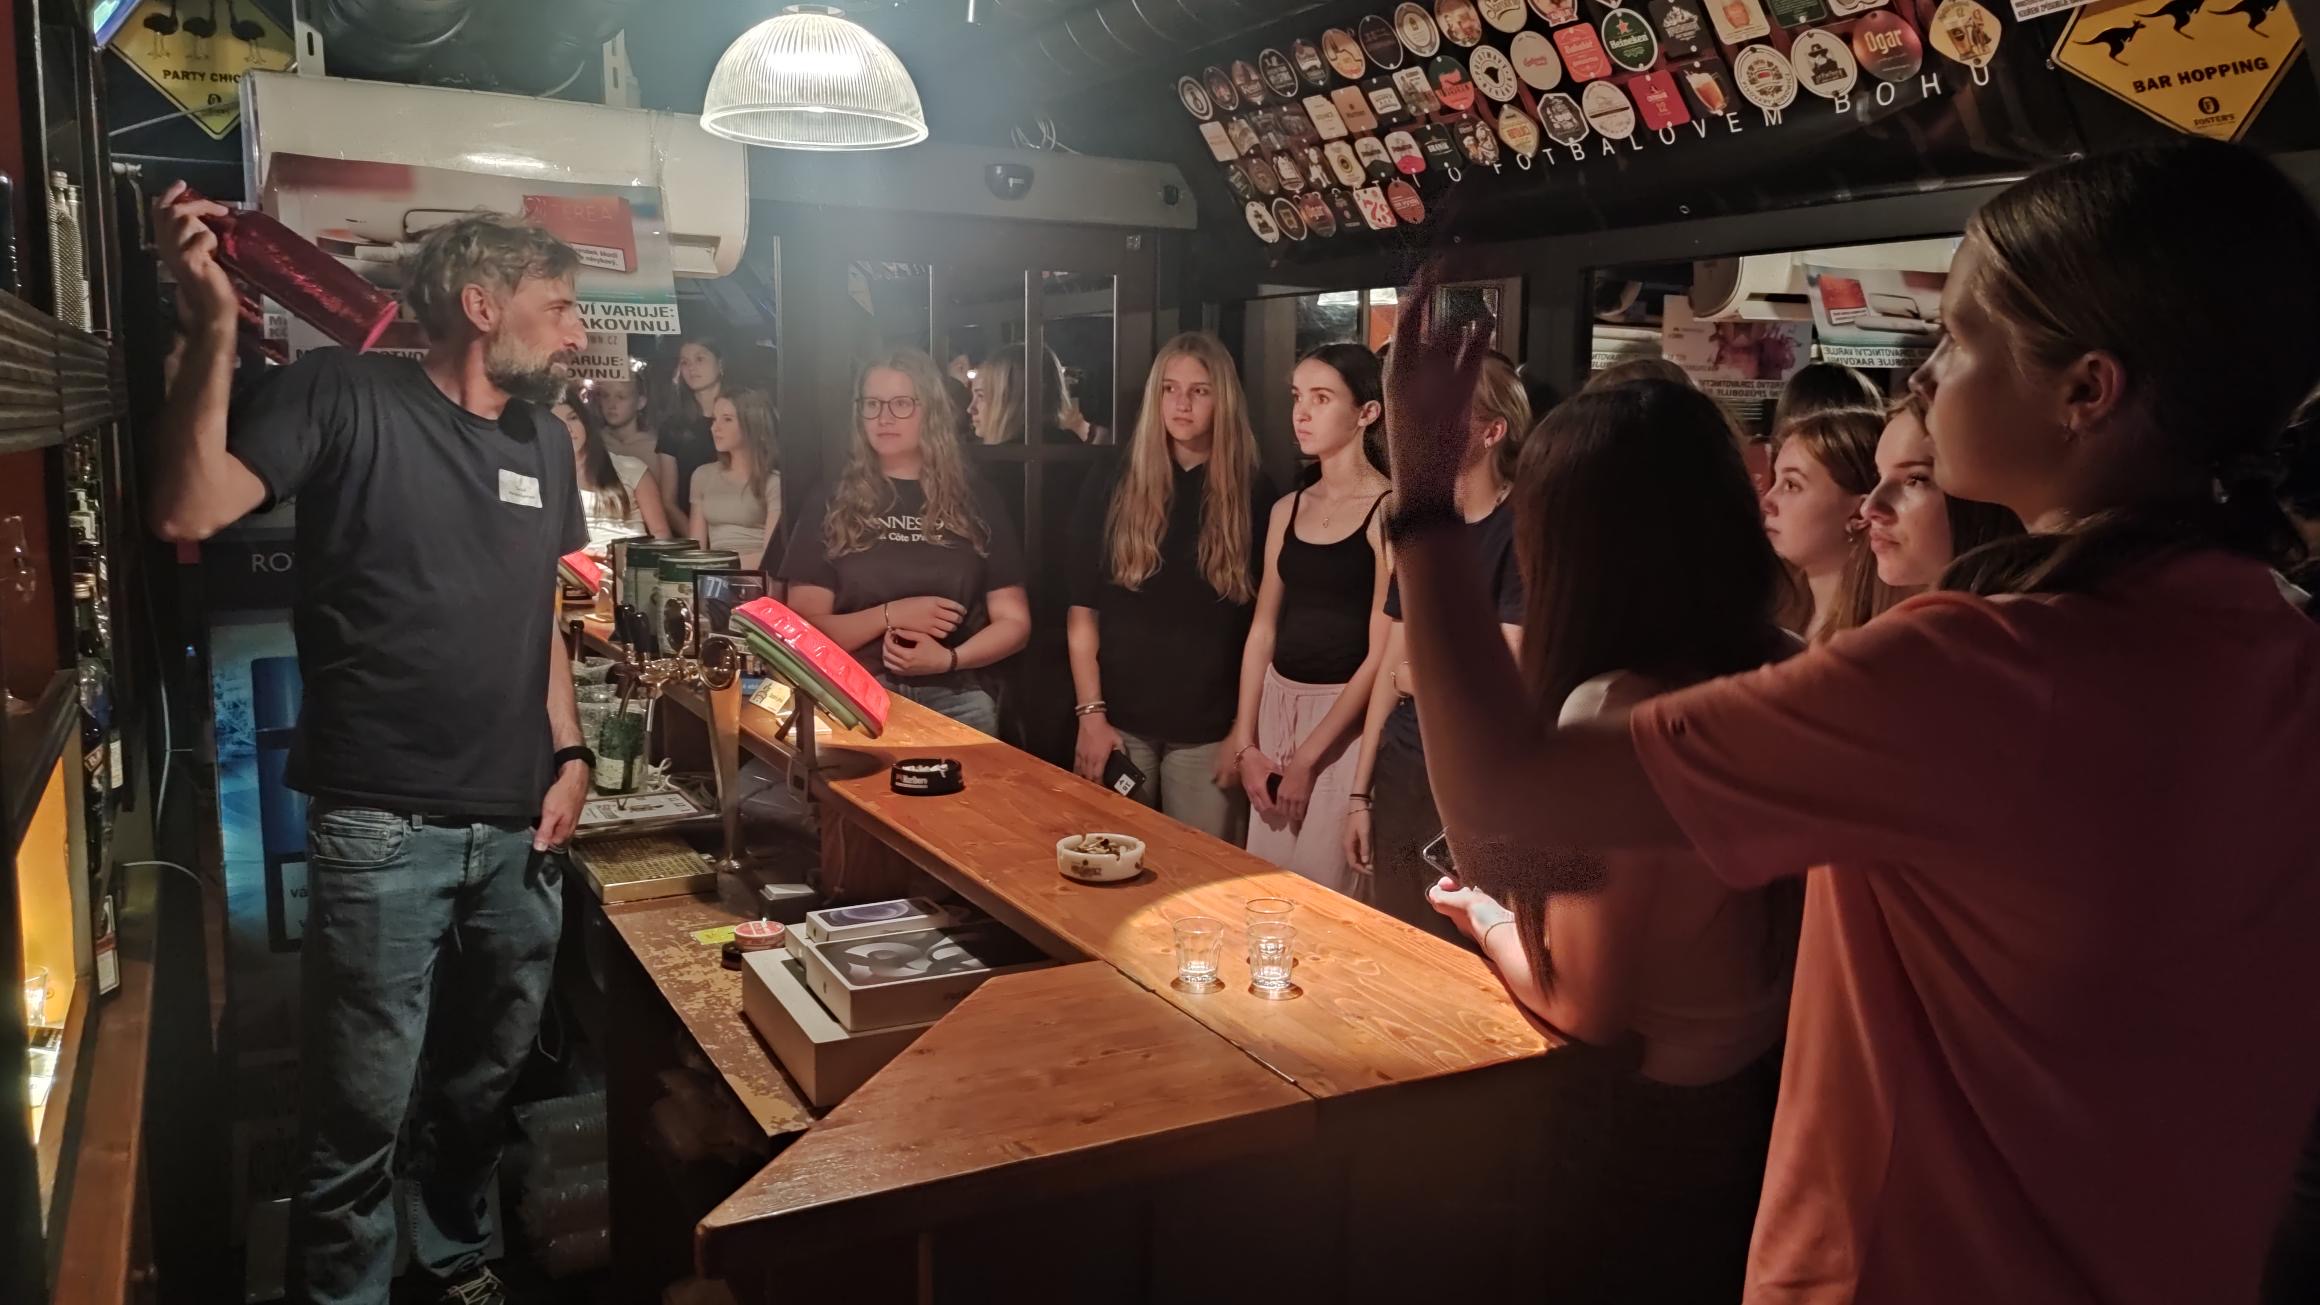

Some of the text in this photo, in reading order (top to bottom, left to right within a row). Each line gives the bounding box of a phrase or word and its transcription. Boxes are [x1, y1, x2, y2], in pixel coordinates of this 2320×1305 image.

[1609, 33, 1649, 50] Heineken
[1863, 27, 1903, 55] Ogar
[162, 69, 242, 84] PARTY CHIC
[2132, 57, 2269, 94] BAR HOPPING
[1834, 67, 1991, 114] BOHU
[600, 304, 674, 318] VARUJE:
[578, 317, 676, 332] AKOVINU.
[571, 355, 624, 366] ARUJE:
[568, 367, 625, 379] OVINU.
[878, 516, 923, 531] NNES
[888, 532, 910, 542] Côte
[251, 552, 296, 573] RO
